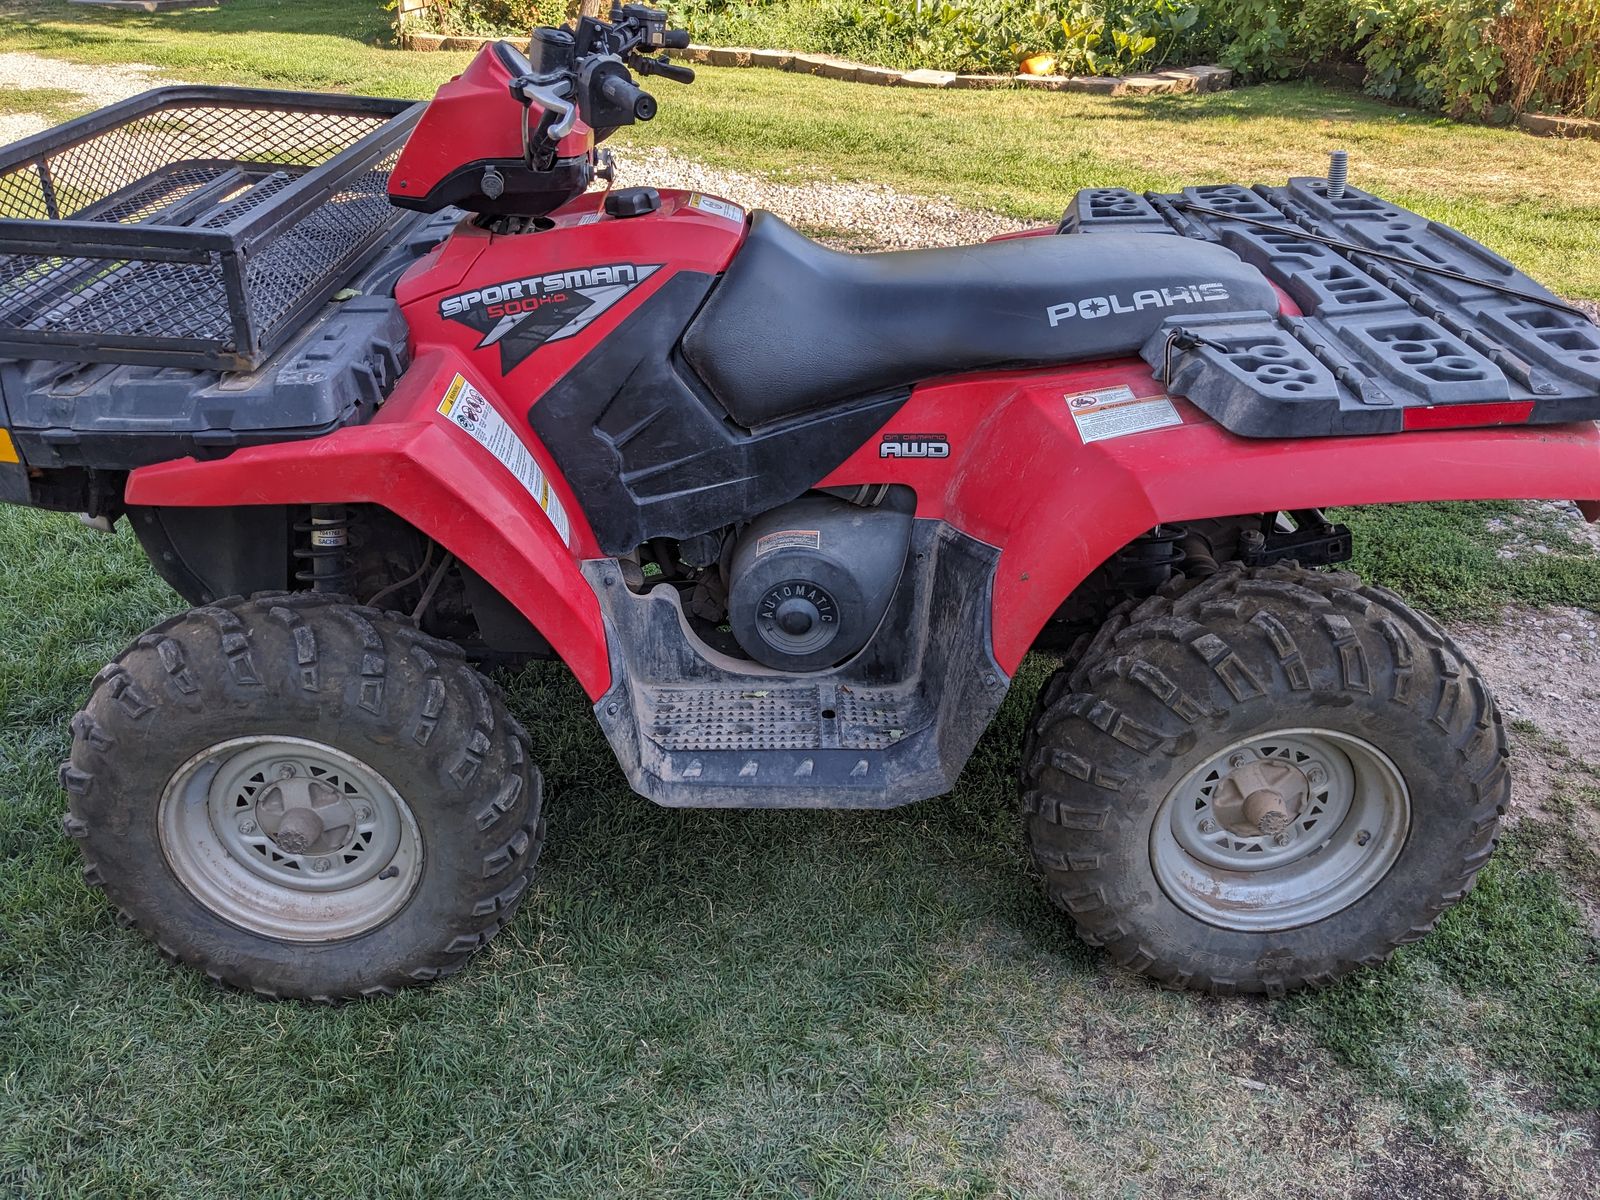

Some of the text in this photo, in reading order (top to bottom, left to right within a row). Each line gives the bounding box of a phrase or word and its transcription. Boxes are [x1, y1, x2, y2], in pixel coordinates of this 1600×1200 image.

[441, 265, 635, 317] SPORTSMAN
[487, 299, 539, 319] 500
[1046, 282, 1230, 327] POLARIS
[880, 442, 949, 458] AWD
[762, 585, 833, 622] AUTOMATIC
